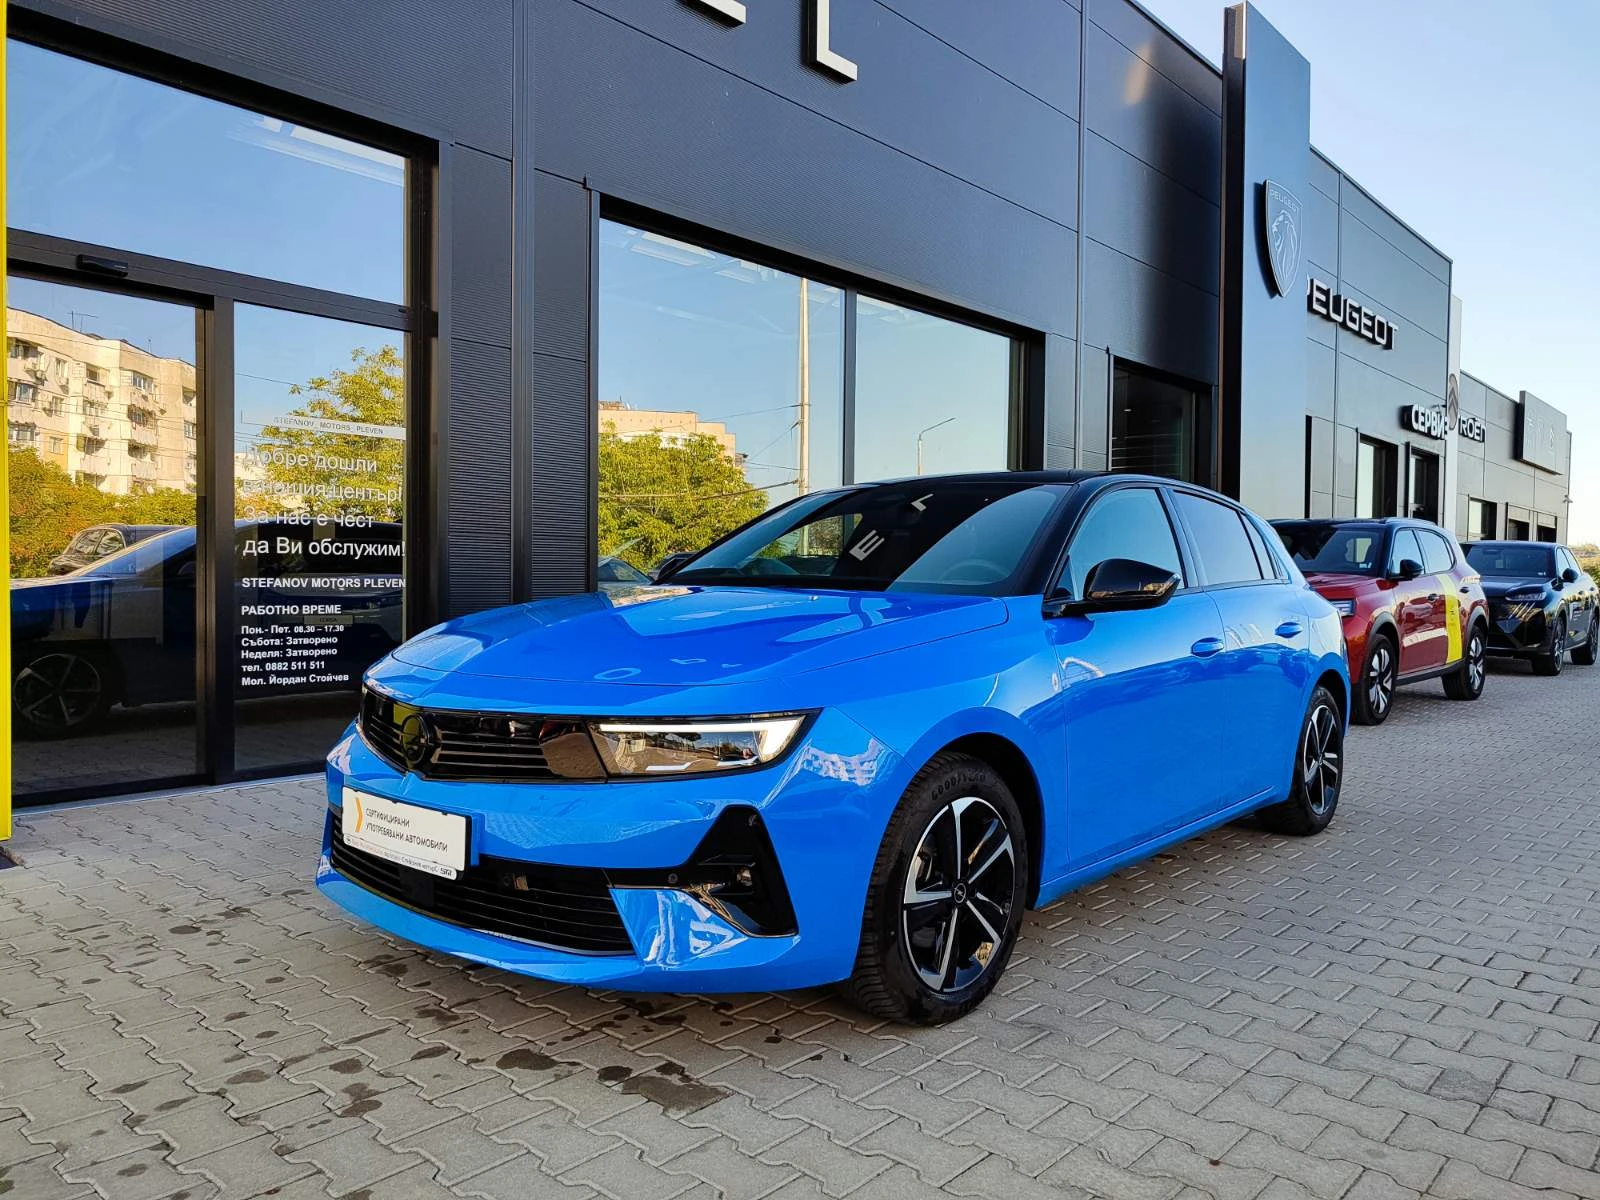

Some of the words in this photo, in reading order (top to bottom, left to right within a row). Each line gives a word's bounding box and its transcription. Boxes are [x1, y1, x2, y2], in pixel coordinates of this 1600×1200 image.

[1306, 273, 1399, 351] EUGEOT
[315, 454, 377, 473] дошли
[243, 506, 270, 525] За
[276, 511, 312, 526] нас
[316, 512, 328, 526] е
[336, 514, 376, 528] чест
[242, 540, 270, 557] да
[276, 536, 303, 554] Ви
[308, 538, 406, 560] обслужим!
[241, 577, 308, 588] STEFANOV
[311, 577, 361, 589] MOTORS
[363, 578, 406, 588] PLEVEN
[241, 605, 300, 615] РАБОТНО
[302, 604, 342, 615] ВРЕМЕ
[241, 637, 284, 647] Събота:
[286, 636, 339, 646] Затворено
[241, 649, 284, 660] Неделя:
[286, 648, 338, 658] Затворено
[241, 664, 263, 672] тел.
[265, 661, 289, 671] 0882
[291, 661, 307, 670] 511
[309, 660, 325, 670] 511
[241, 677, 267, 686] Мол.
[269, 674, 307, 686] Йордан
[309, 673, 350, 682] Стойчев
[405, 835, 448, 853] АВТОМОБИЛИ
